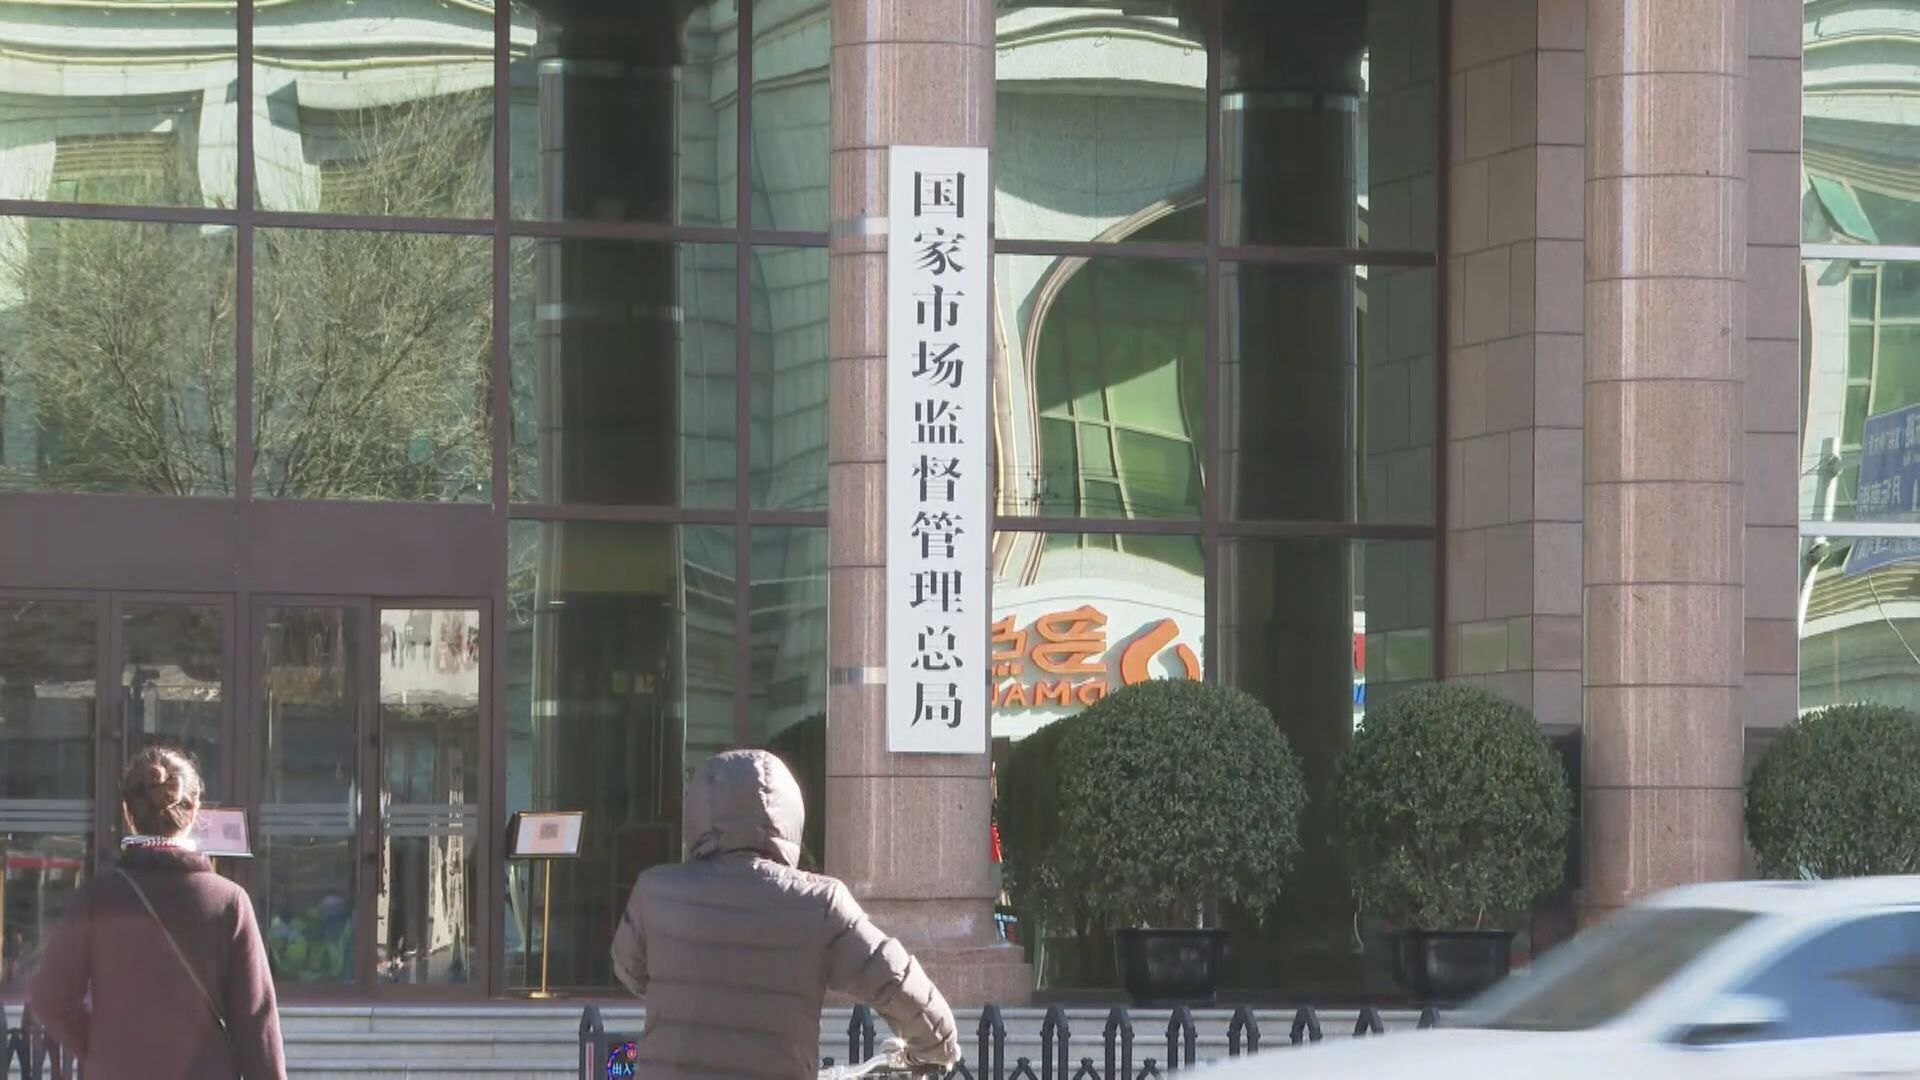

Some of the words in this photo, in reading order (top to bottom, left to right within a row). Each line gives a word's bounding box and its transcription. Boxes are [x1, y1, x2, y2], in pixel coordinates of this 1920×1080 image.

[910, 171, 966, 728] 国家市场监督管理总局
